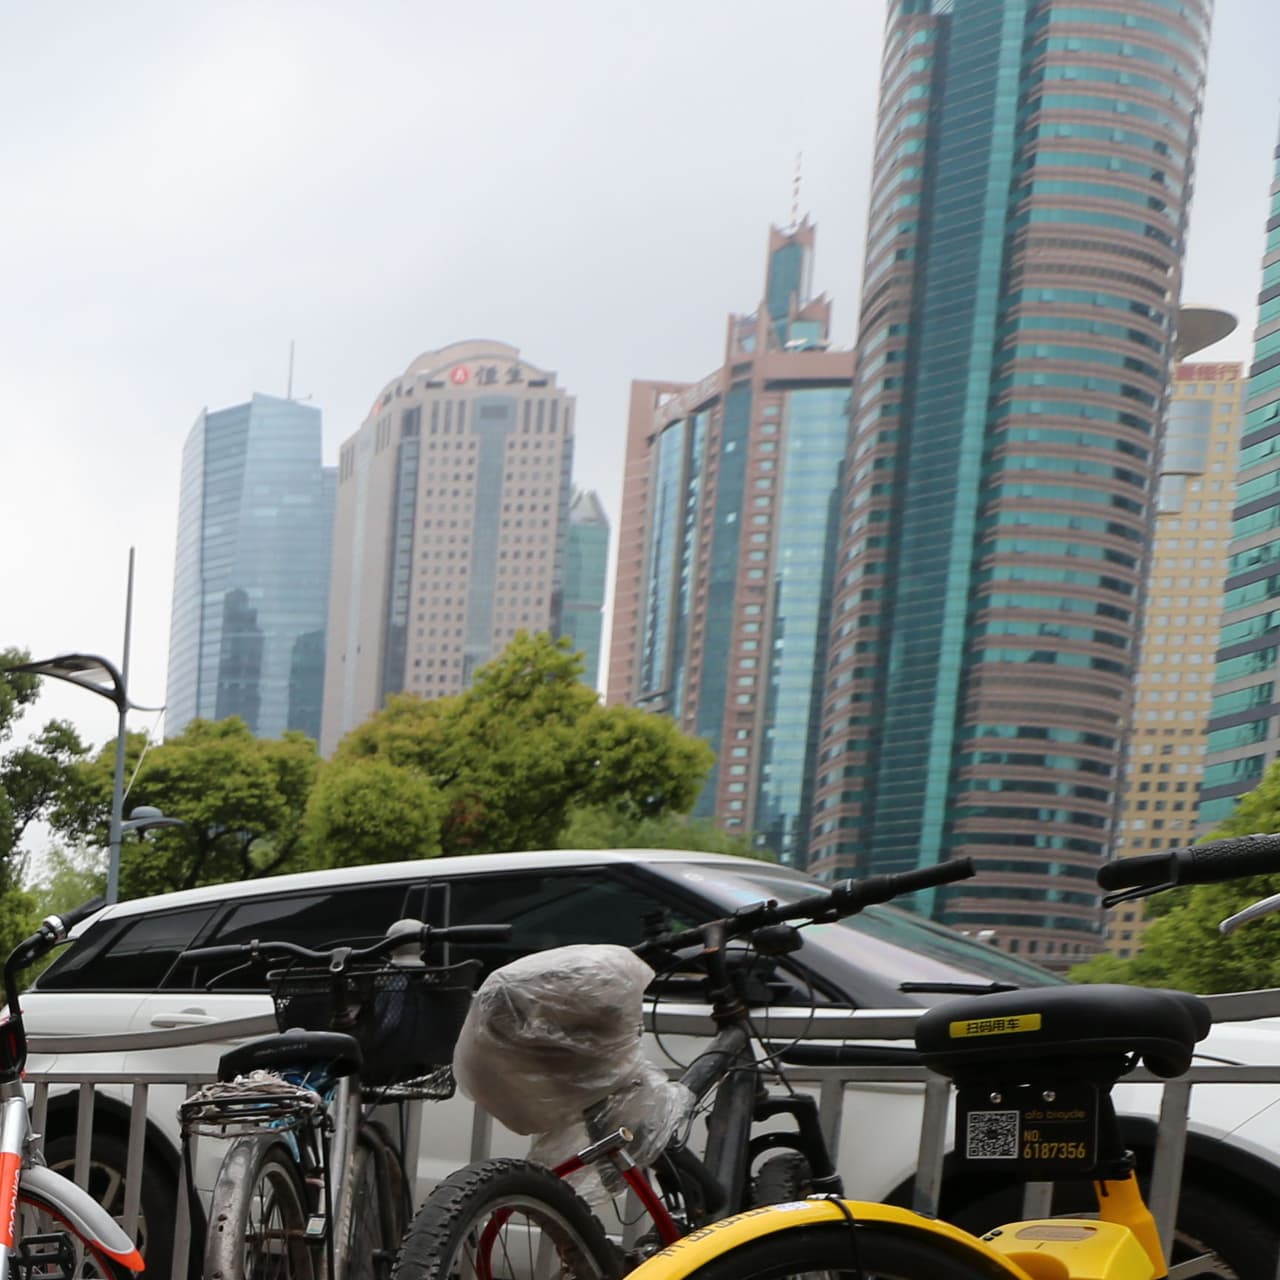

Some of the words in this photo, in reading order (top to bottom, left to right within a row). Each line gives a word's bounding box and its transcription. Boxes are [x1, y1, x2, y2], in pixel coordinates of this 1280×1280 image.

[966, 1018, 1020, 1034] 扫码用车
[1024, 1143, 1086, 1159] 6187356
